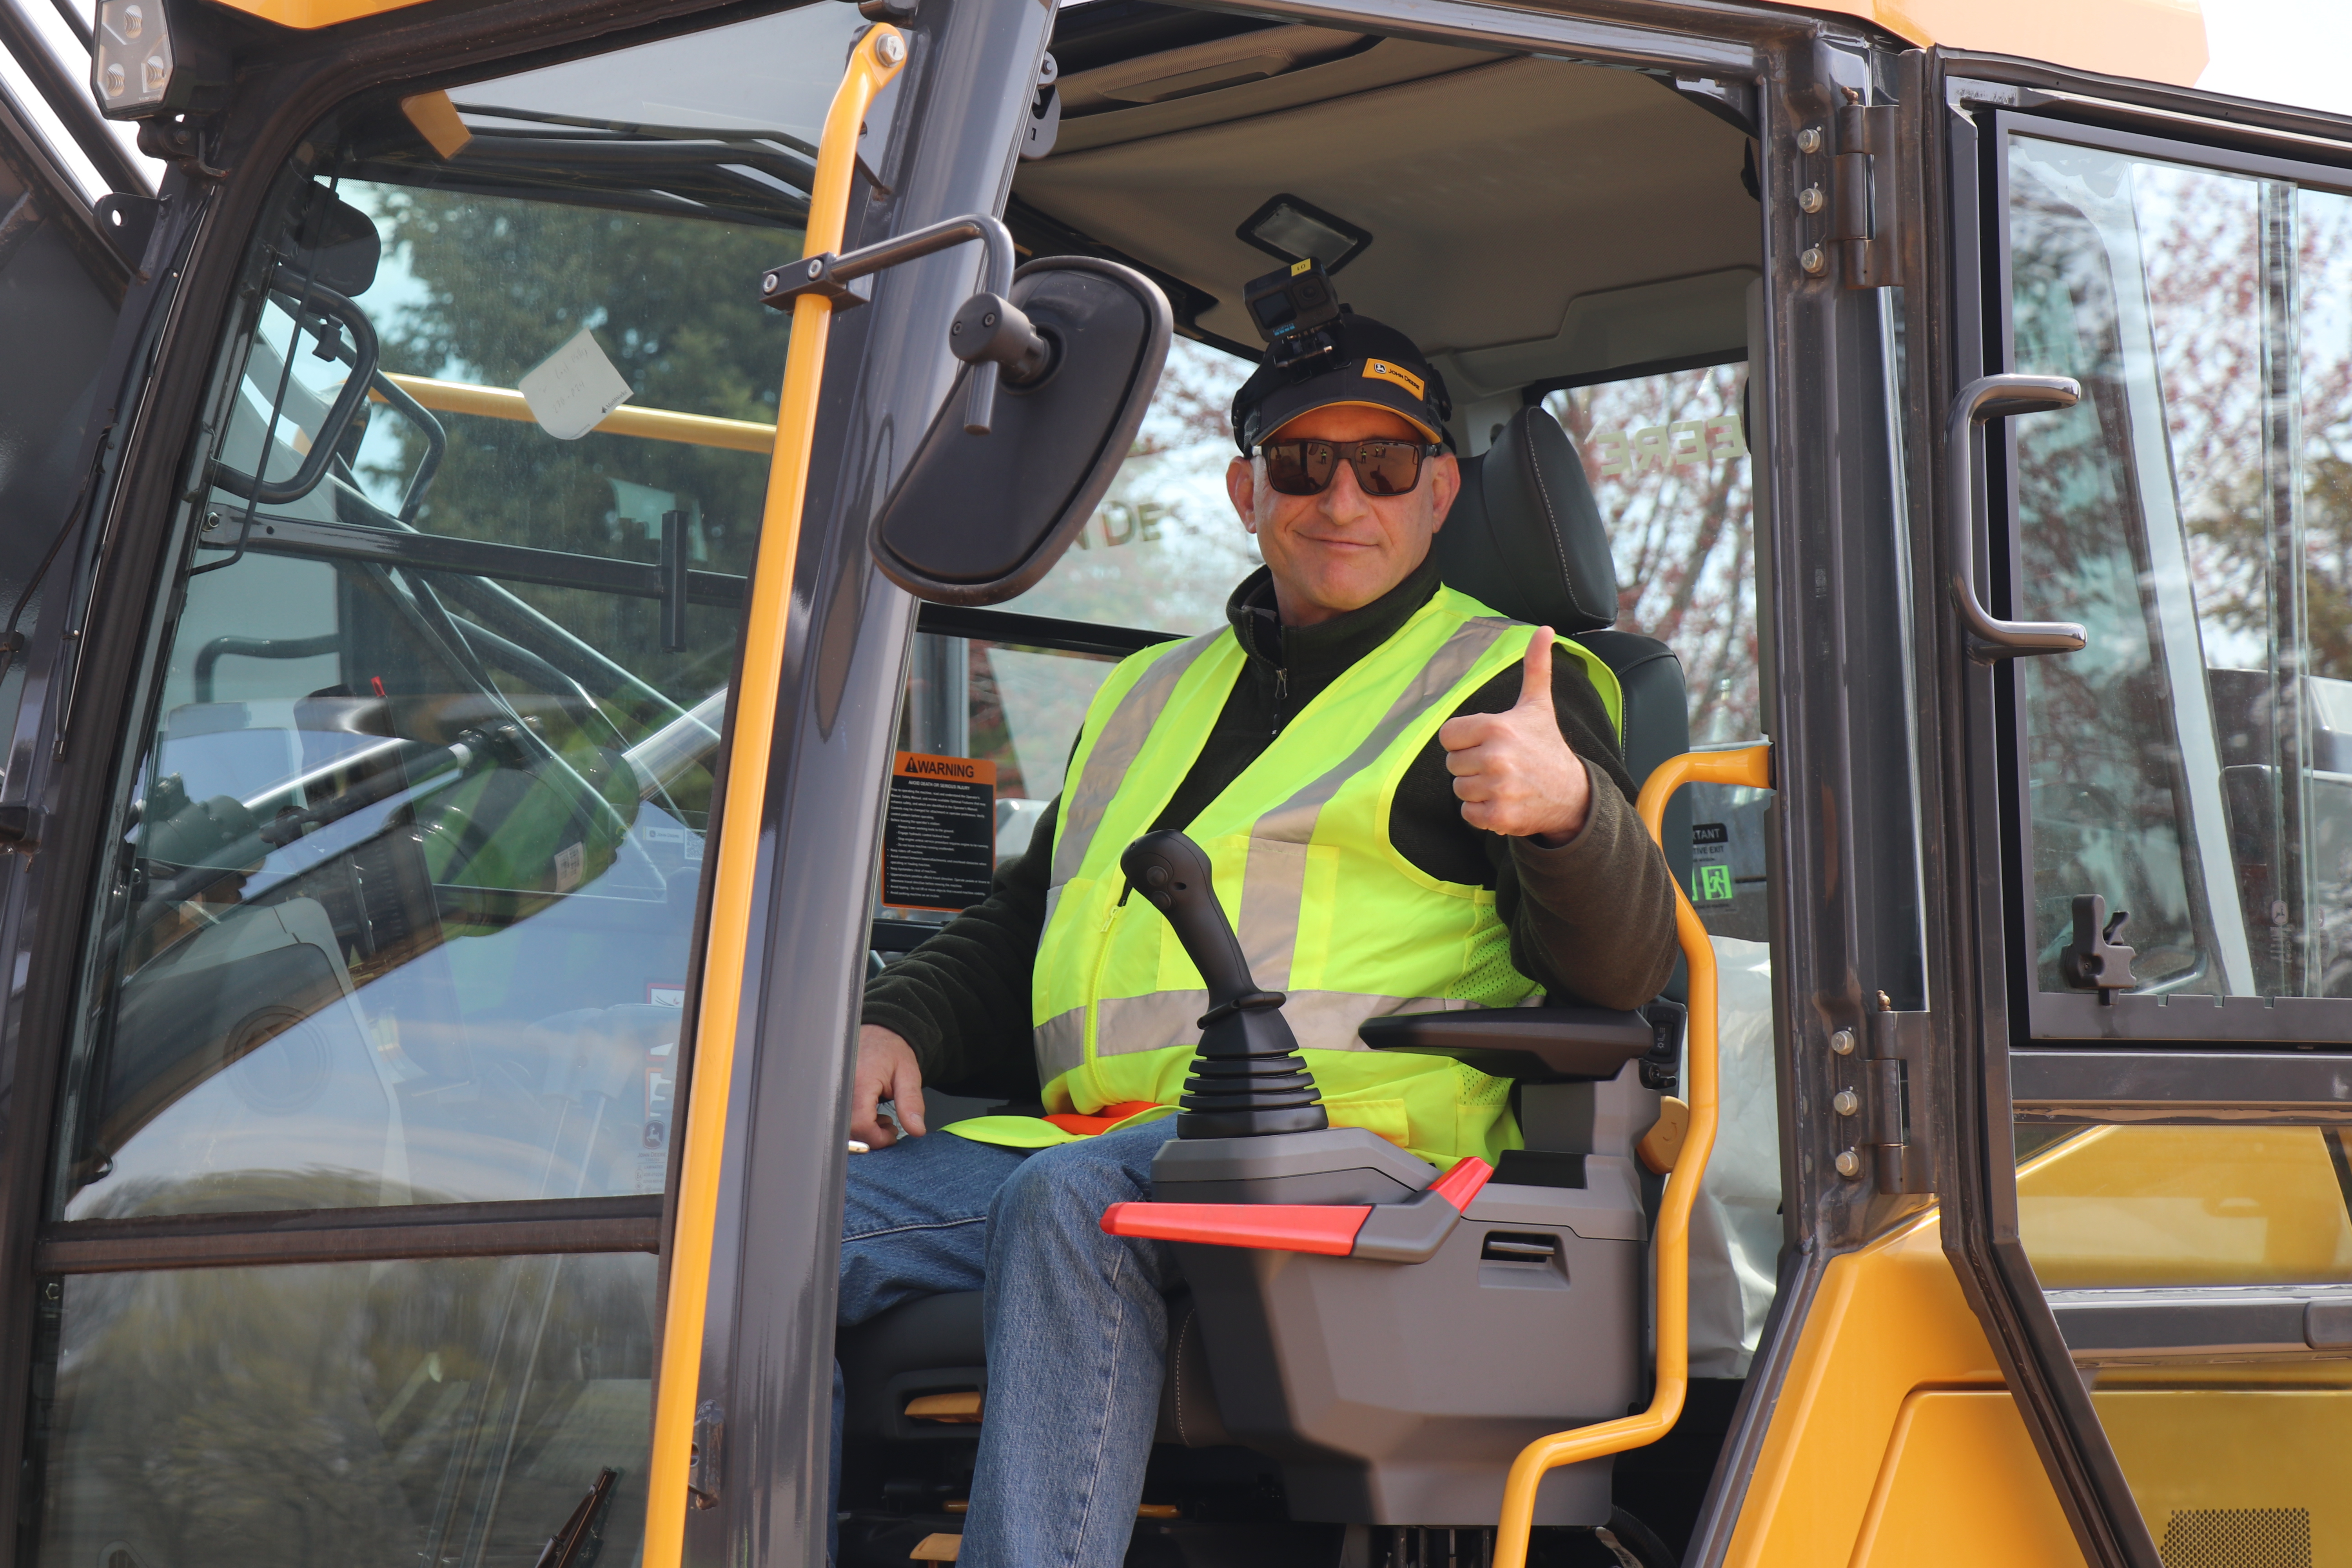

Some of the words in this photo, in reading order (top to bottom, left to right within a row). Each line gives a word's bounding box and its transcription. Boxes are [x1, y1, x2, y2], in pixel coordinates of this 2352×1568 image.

[1388, 368, 1403, 379] JOHN
[1404, 375, 1420, 390] DEERE
[605, 390, 628, 410] MathWorks
[918, 760, 975, 778] WARNING
[1709, 845, 1724, 853] EXIT
